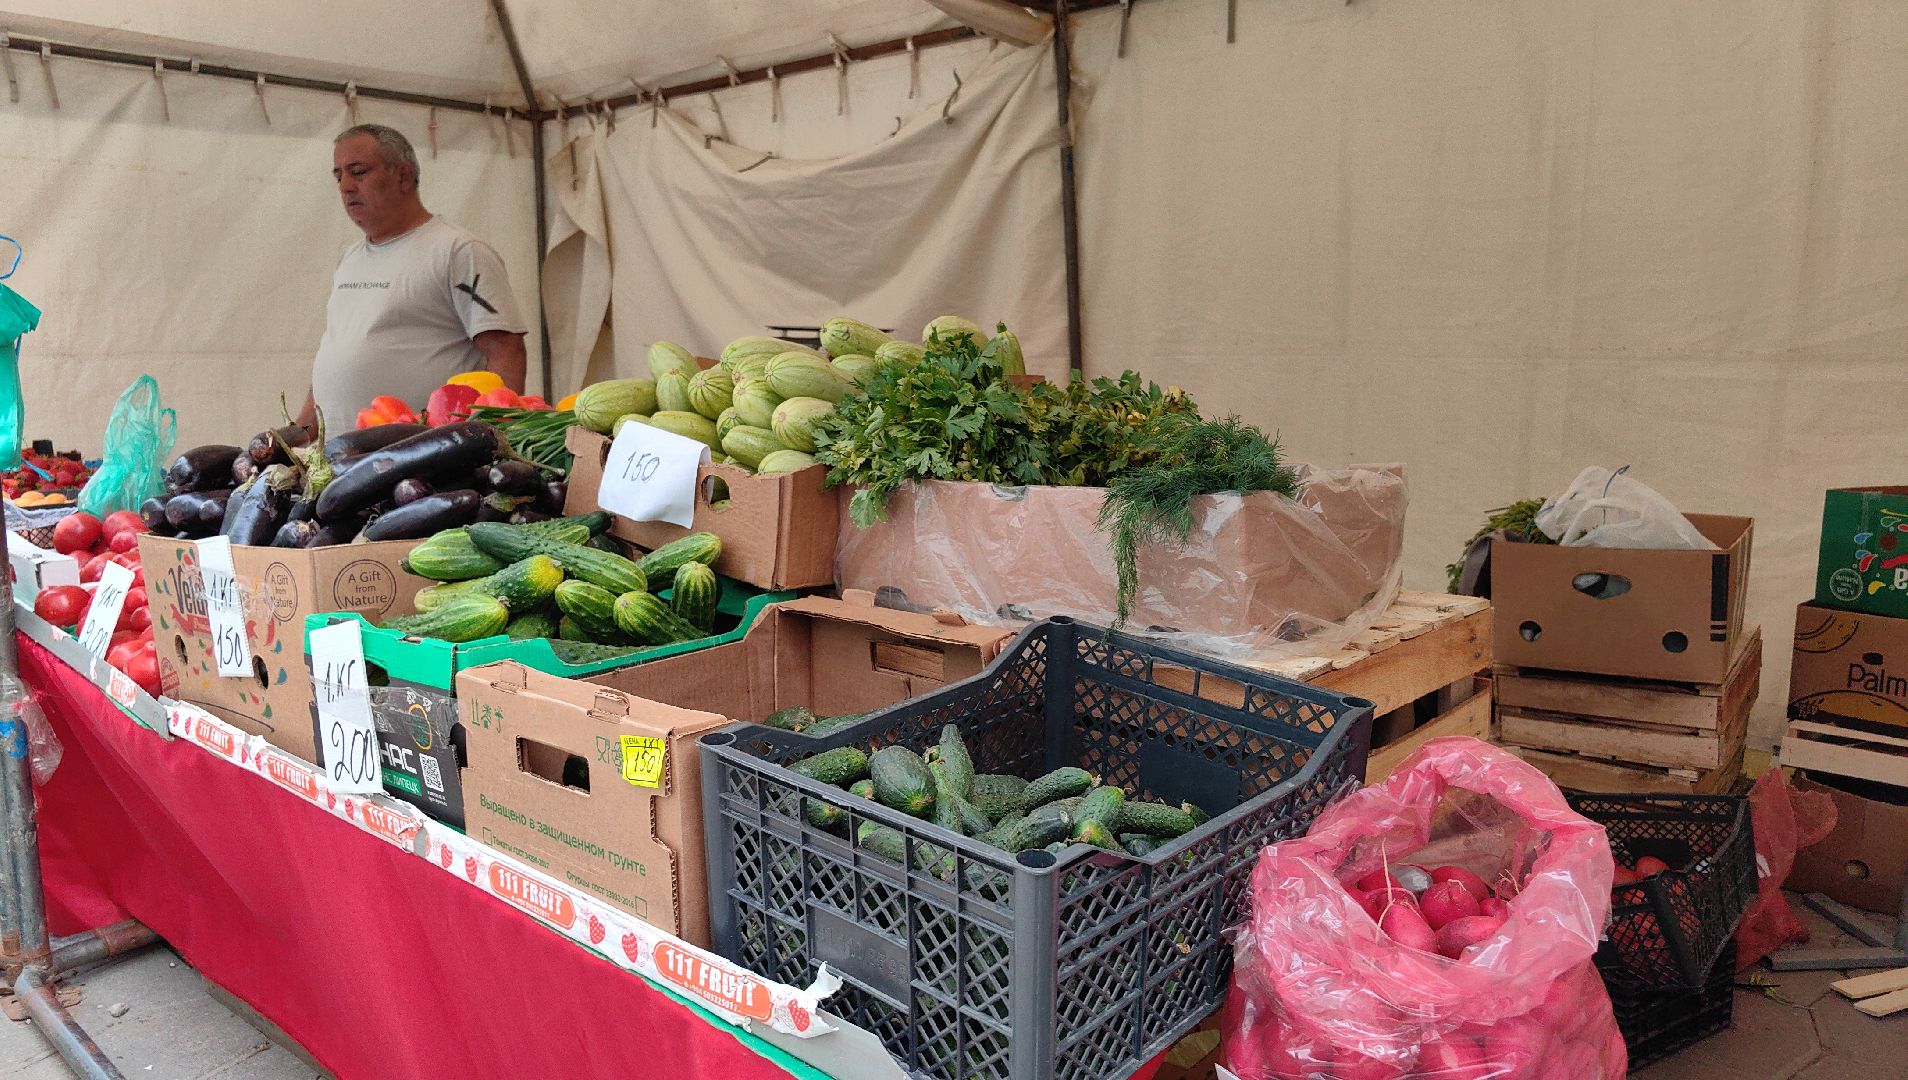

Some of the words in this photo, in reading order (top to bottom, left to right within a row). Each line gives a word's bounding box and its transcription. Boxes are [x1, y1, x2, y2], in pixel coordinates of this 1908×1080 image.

[622, 451, 660, 481] 150
[271, 575, 276, 584] A
[276, 575, 289, 586] Gift
[348, 573, 356, 583] A
[360, 571, 381, 582] Gift
[355, 584, 376, 593] from
[270, 596, 293, 608] Nature
[344, 594, 388, 607] Nature
[217, 624, 243, 669] 150
[1846, 663, 1907, 697] Palm
[331, 721, 375, 785] 200
[634, 750, 655, 773] 150
[286, 766, 310, 791] FRUIT
[367, 806, 386, 828] 111
[480, 793, 527, 826] Выращено
[529, 818, 535, 829] в
[537, 821, 605, 859] защищенном
[608, 851, 647, 877] грунте
[566, 870, 590, 888] Огурцы
[498, 868, 519, 895] 111
[522, 878, 563, 915] FRUIT
[665, 948, 694, 980] 111
[699, 962, 757, 1007] FRUIT
